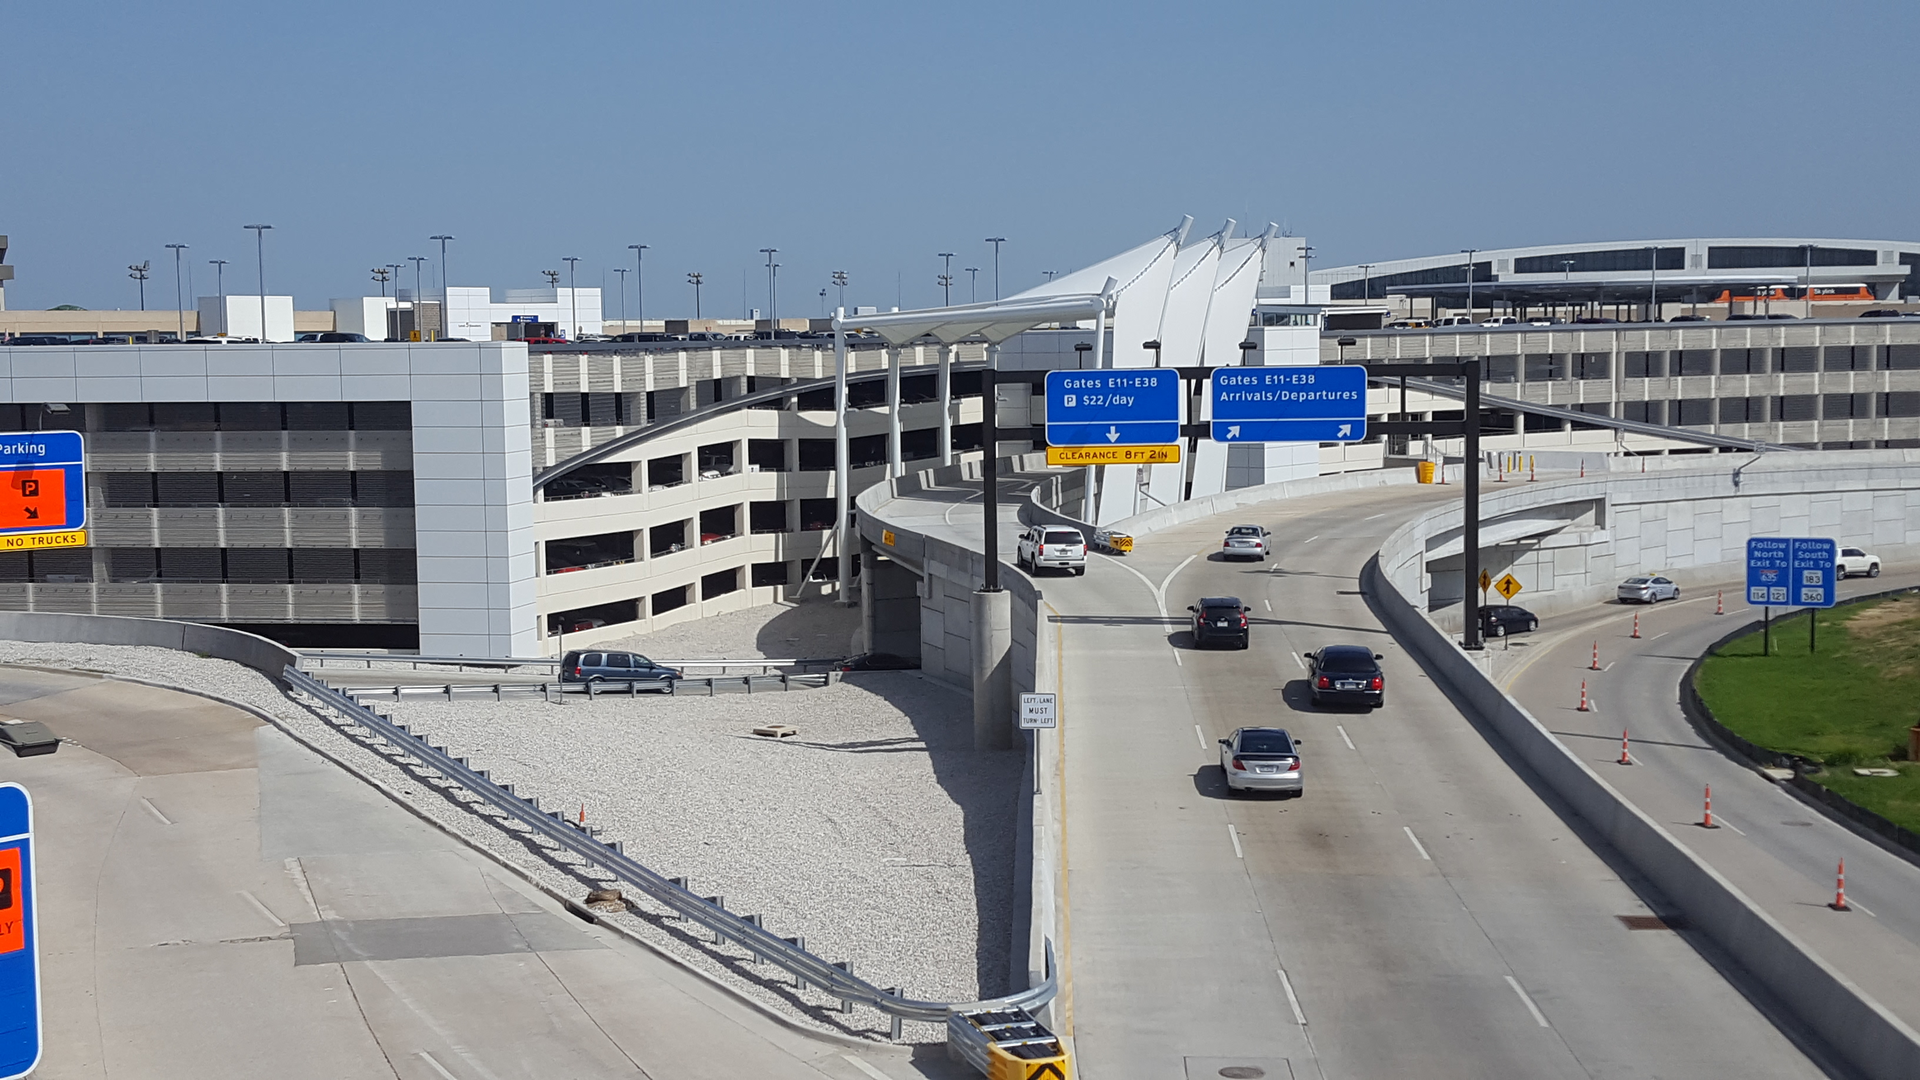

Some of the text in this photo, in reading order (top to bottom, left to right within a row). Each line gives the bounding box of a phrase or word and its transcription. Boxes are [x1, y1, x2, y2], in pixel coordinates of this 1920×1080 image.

[1064, 378, 1158, 388] Gates E11-E38
[1220, 374, 1315, 385] Gates E11-E38
[1066, 394, 1134, 407] P $22/day
[1220, 390, 1358, 402] Arrivals/Departures
[1059, 451, 1118, 460] CLEARANCE
[24, 481, 37, 496] P
[6, 534, 76, 547] NO TRUCKS
[1805, 576, 1820, 584] 183
[1752, 592, 1786, 600] 114 121
[1803, 592, 1822, 601] 360
